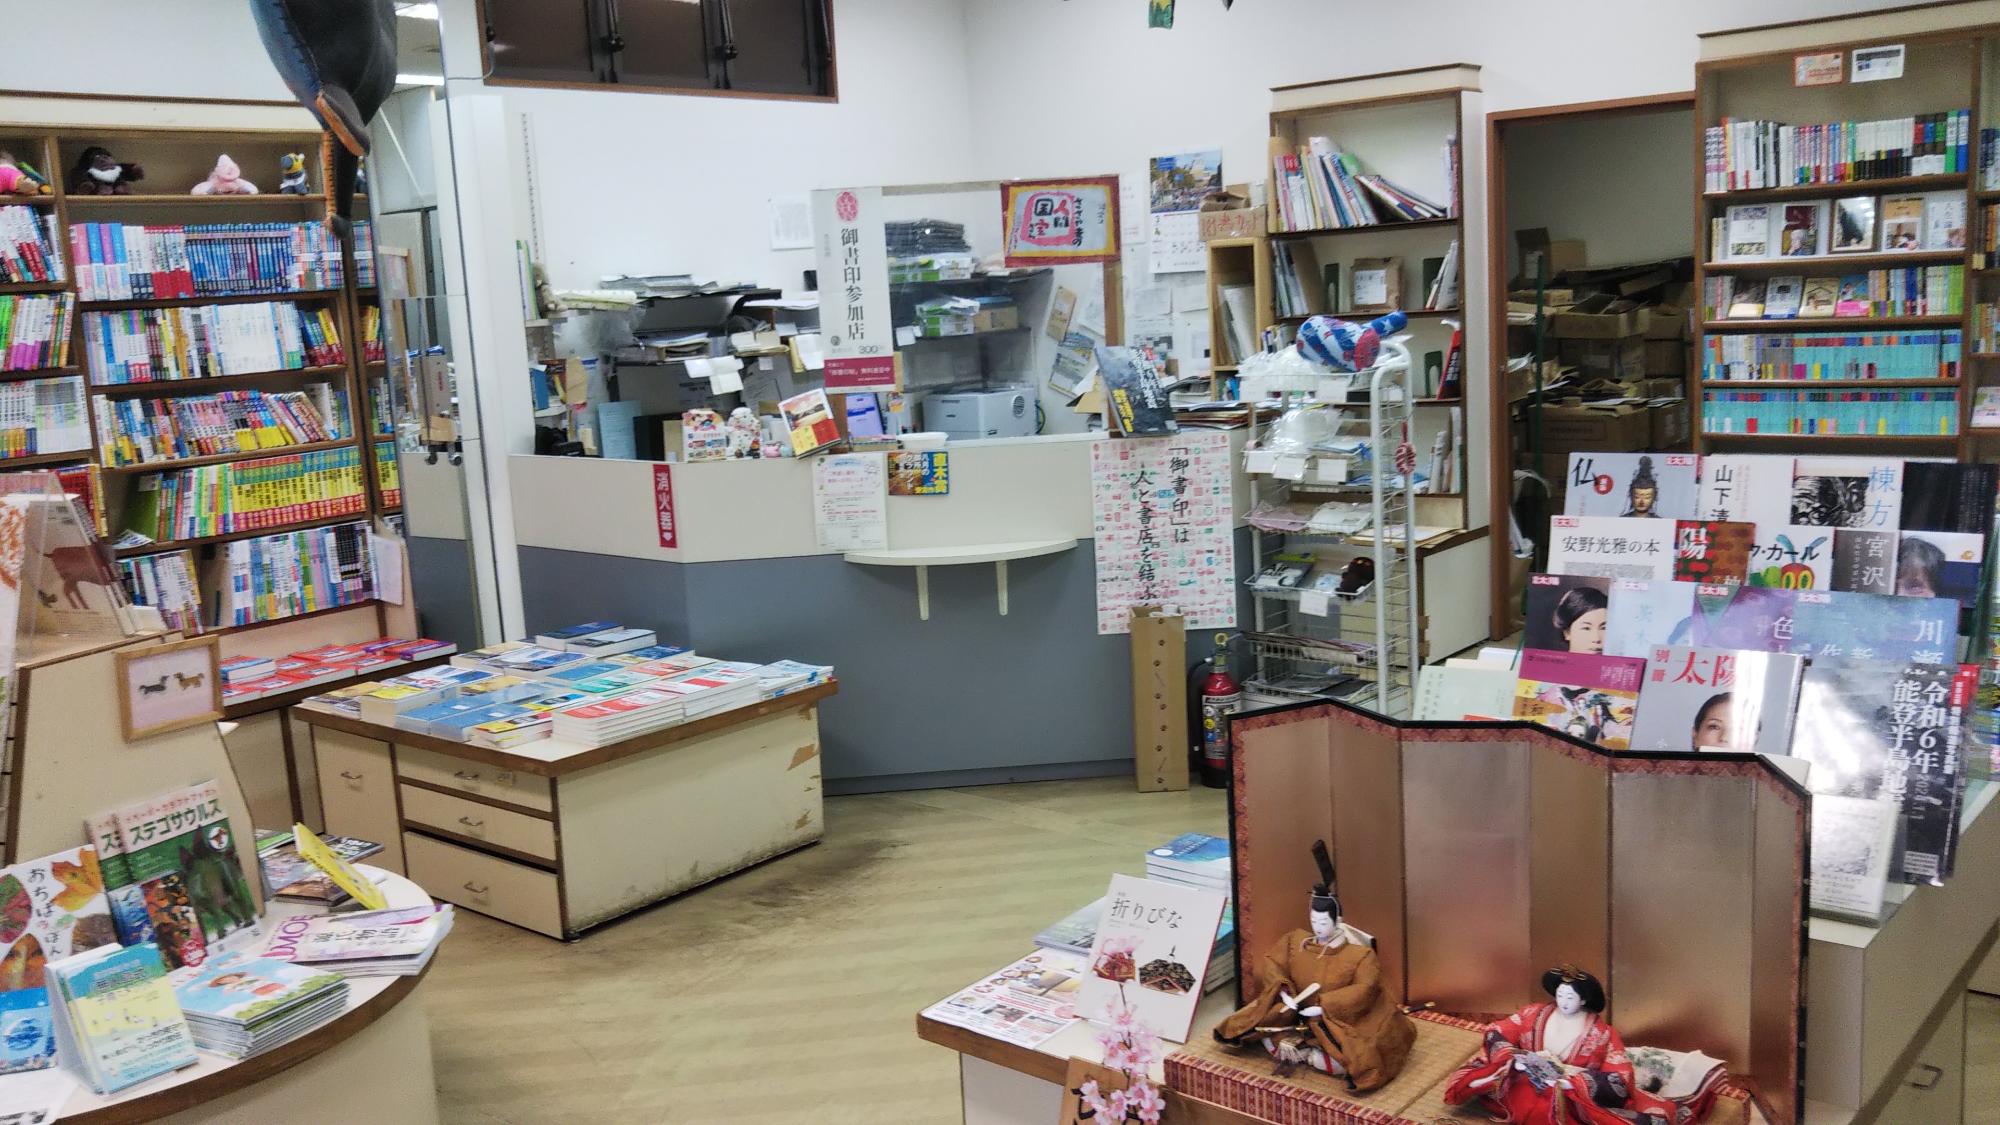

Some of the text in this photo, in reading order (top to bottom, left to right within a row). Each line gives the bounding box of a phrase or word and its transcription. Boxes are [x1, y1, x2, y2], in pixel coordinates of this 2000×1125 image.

[841, 228, 865, 340] 御書印参加店
[656, 472, 673, 531] 消火器
[933, 453, 947, 493] 直木賞
[1168, 447, 1190, 544] 「御書印」は
[1571, 457, 1599, 488] 仏
[1710, 464, 1733, 522] 山下清
[1864, 465, 1896, 527] 棟方
[1131, 470, 1160, 600] 人と書店を結ぶ
[1562, 535, 1661, 555] 安野光雅の本
[1861, 536, 1890, 587] 宮沢
[1911, 681, 1950, 775] 令和6年
[128, 798, 222, 846] ステゴサウルス
[1110, 896, 1186, 929] 折りびな
